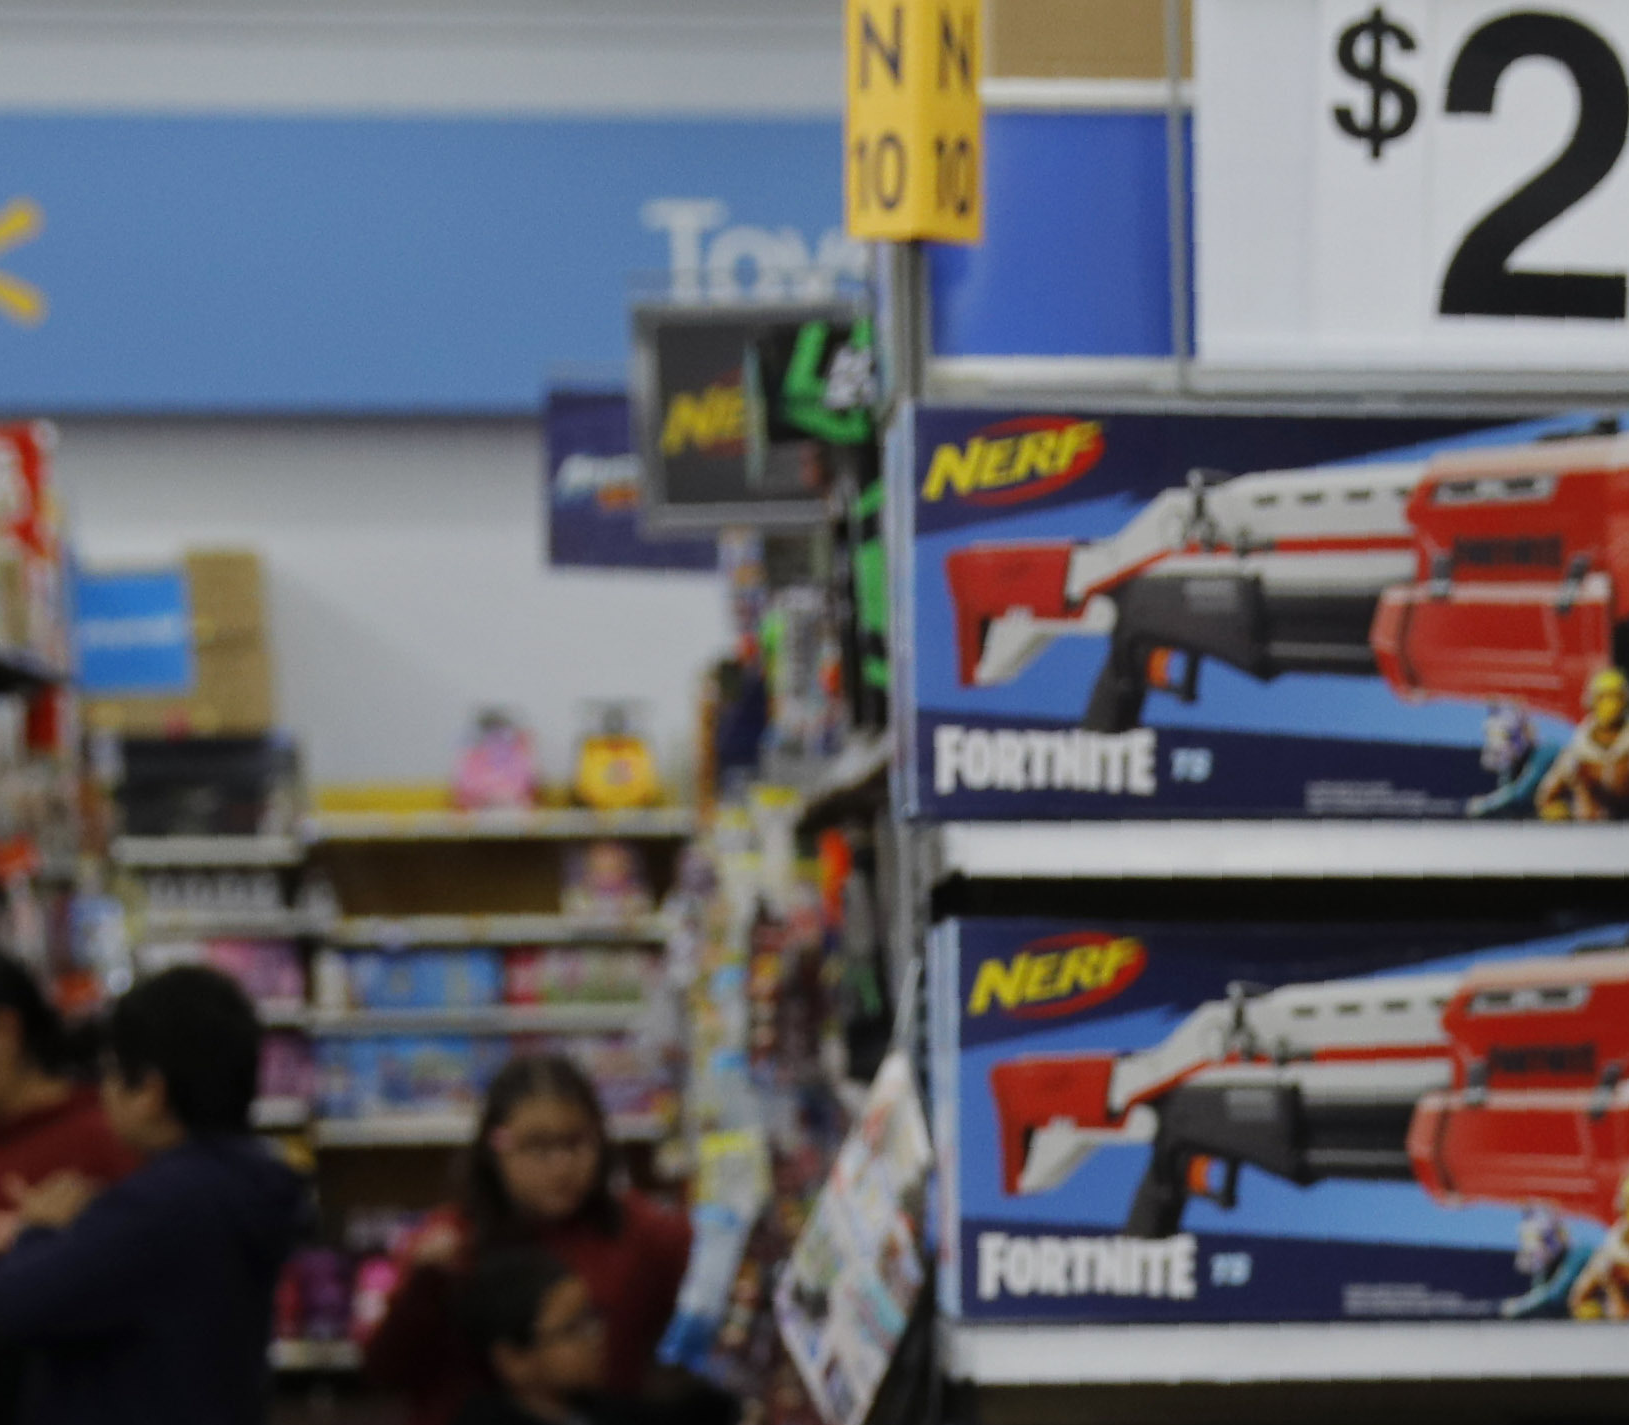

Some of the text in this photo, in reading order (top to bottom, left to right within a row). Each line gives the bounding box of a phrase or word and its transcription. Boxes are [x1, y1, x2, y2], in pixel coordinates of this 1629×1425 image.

[860, 12, 905, 94] N
[853, 132, 907, 212] 10
[920, 418, 1108, 506] NERF
[931, 728, 1160, 799] FORTNITE
[967, 936, 1150, 1018] NERF
[976, 1231, 1199, 1300] FORTNITE
